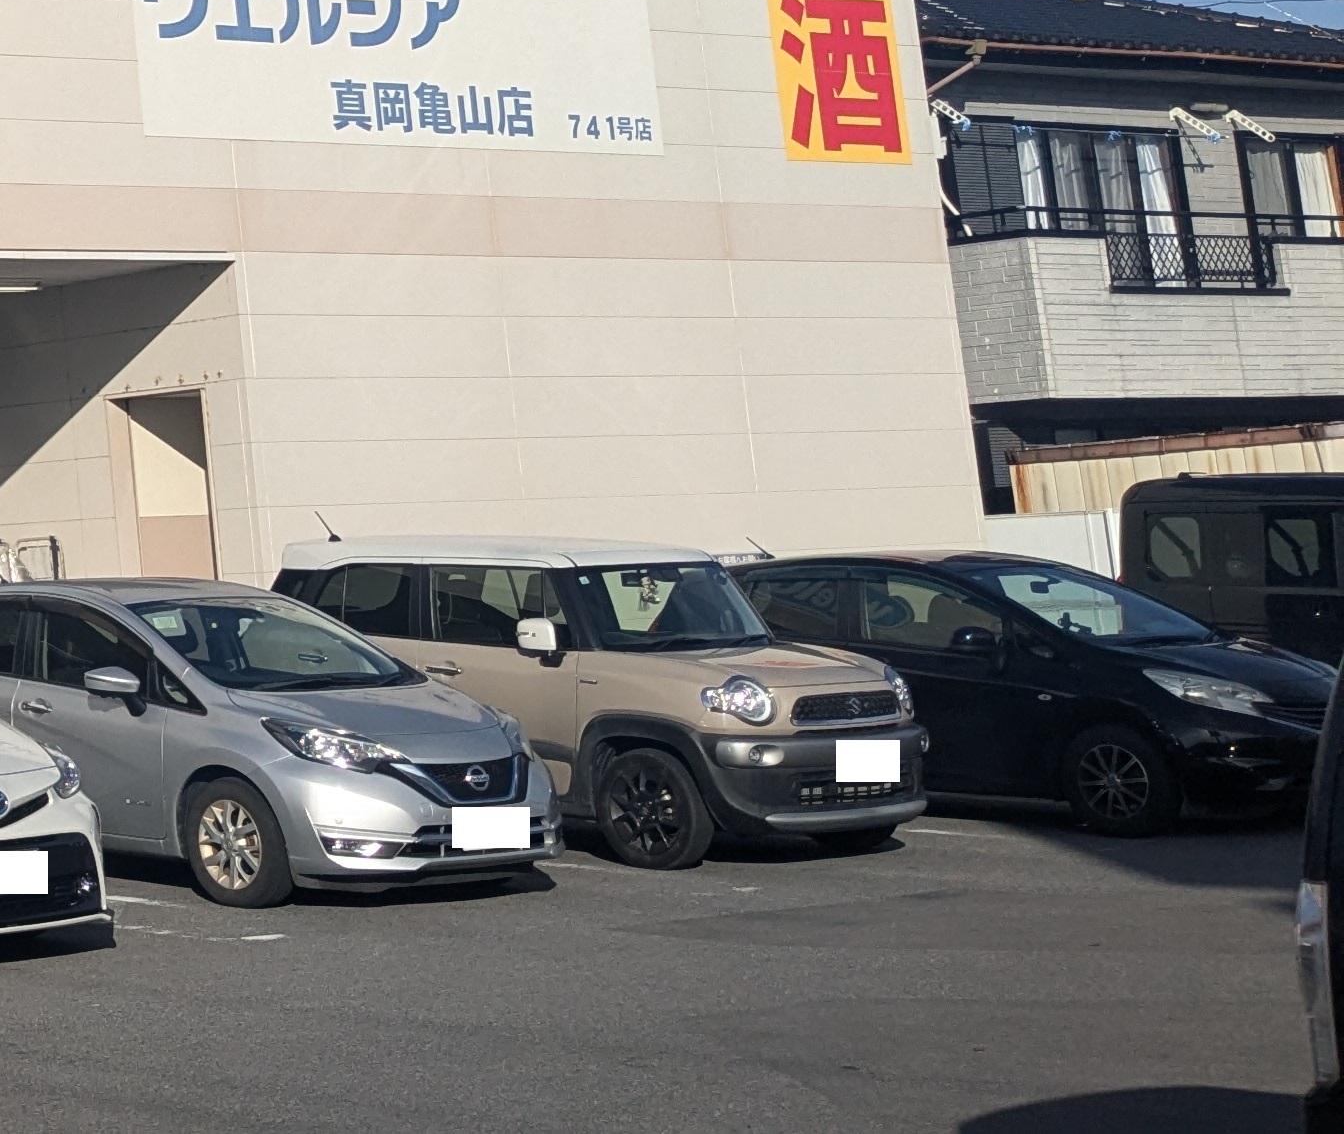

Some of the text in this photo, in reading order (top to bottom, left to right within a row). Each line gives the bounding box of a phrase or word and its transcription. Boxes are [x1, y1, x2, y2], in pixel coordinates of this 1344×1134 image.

[330, 79, 535, 137] 真岡亀山店
[568, 114, 653, 143] 741号店
